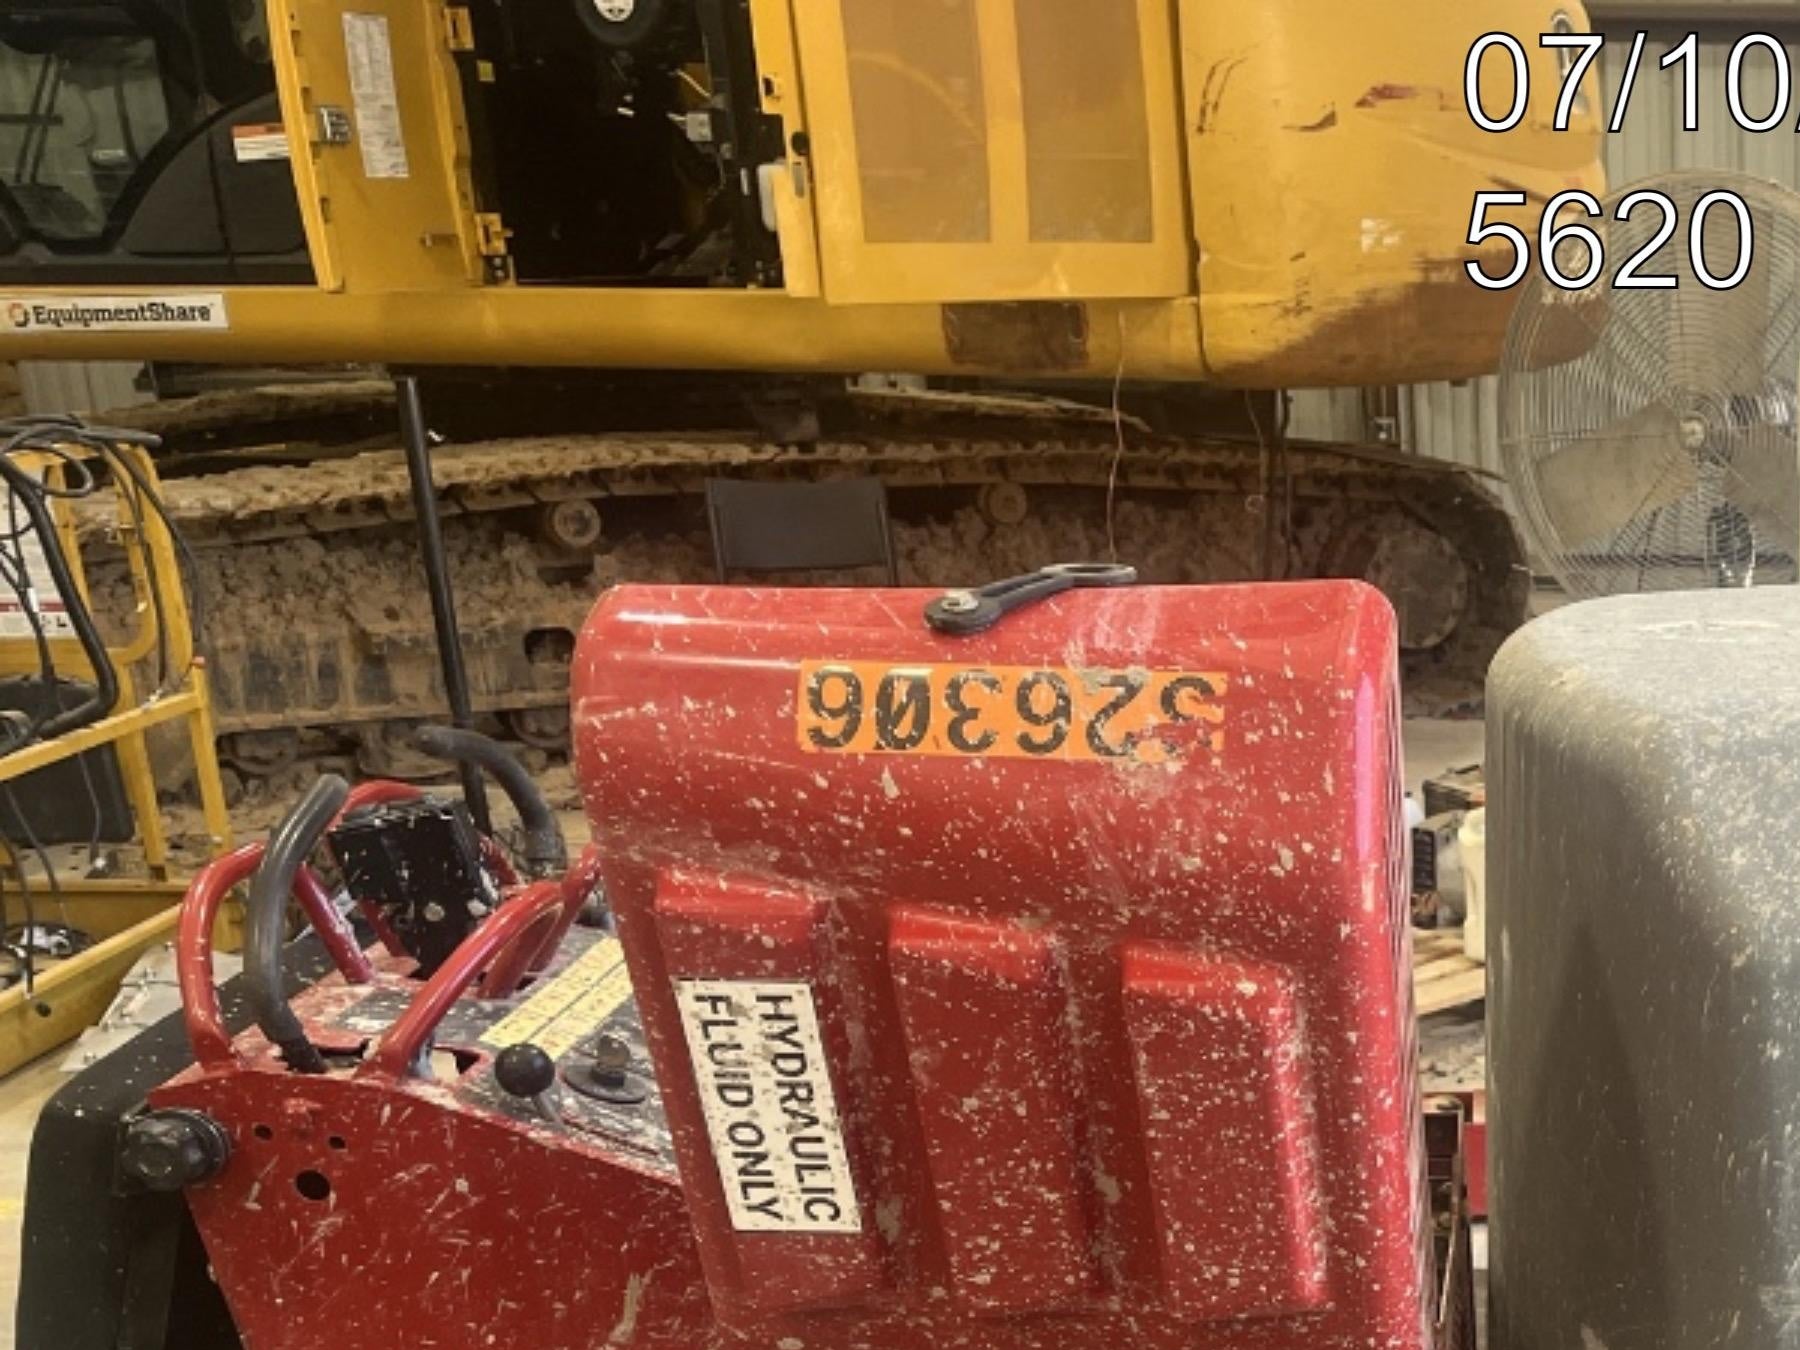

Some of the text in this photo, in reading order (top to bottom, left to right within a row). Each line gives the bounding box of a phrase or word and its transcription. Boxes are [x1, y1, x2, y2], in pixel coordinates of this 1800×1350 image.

[32, 302, 212, 327] EquipmentShare
[693, 995, 784, 1221] FLUID ONLY
[755, 995, 841, 1222] HYDRAULIC
